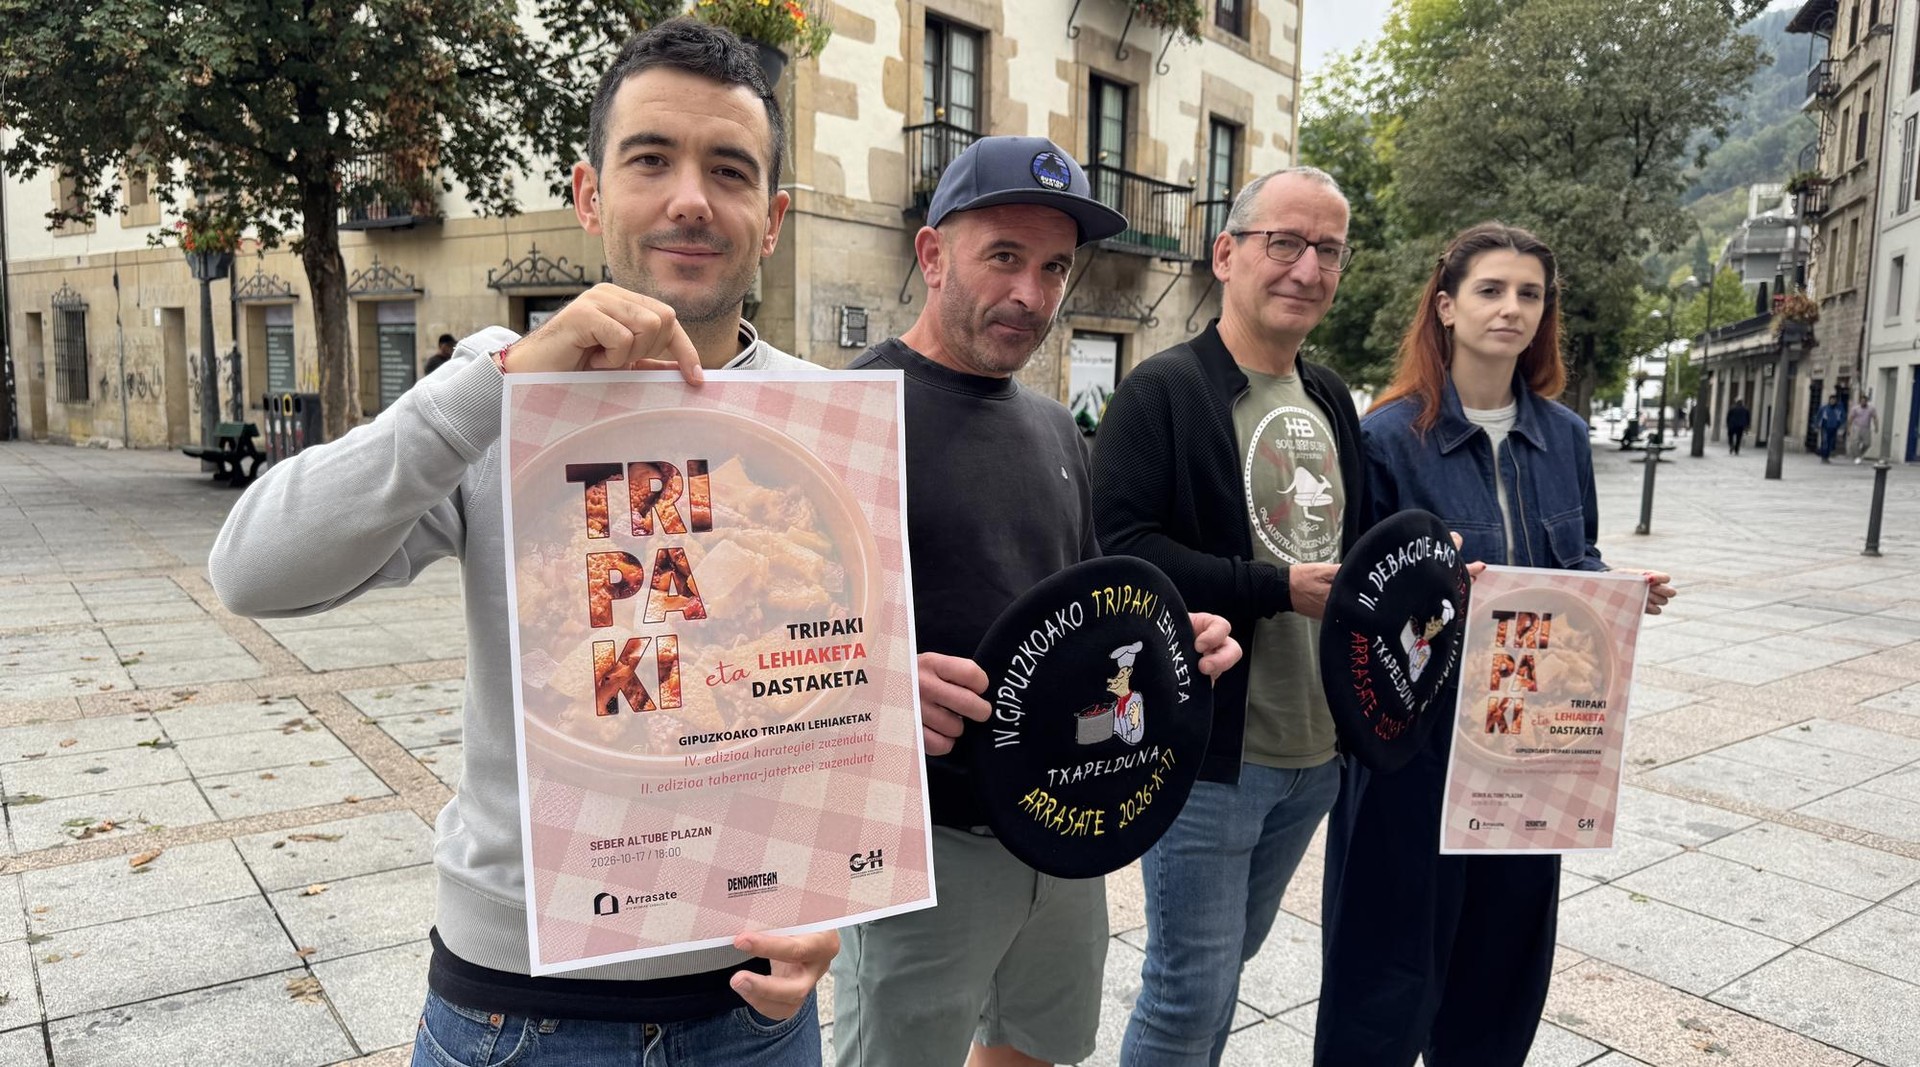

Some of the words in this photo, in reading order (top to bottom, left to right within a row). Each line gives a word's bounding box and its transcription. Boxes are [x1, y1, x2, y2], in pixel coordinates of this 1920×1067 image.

[565, 459, 714, 539] TRI
[586, 547, 708, 628] PA
[1092, 584, 1158, 618] TRIPAKI
[786, 617, 864, 640] TRIPAKI
[1491, 610, 1552, 649] TRI
[758, 643, 867, 670] LEHIAKETA
[1373, 635, 1415, 711] TXAPELDUNA
[1490, 653, 1538, 692] PA
[592, 634, 683, 717] KI
[705, 661, 750, 687] eta
[752, 669, 868, 698] DASTAKETA
[1351, 631, 1378, 718] ARRASATE
[1485, 697, 1524, 734] KI
[1555, 712, 1605, 722] LEHIAKETA
[1571, 700, 1606, 709] TRIPAKI
[678, 728, 758, 746] GIPUZKOAKO
[761, 722, 805, 736] TRIPAKI
[808, 712, 872, 730] LEHIAKETAK
[1550, 726, 1604, 736] DASTAKETA
[684, 755, 701, 767] IV.
[704, 751, 750, 766] edizioa
[753, 742, 815, 759] harategiei
[818, 732, 875, 749] zuzenduta
[1047, 745, 1160, 788] TXAPELDUNA
[641, 783, 653, 794] II.
[657, 778, 704, 793] edizioa
[708, 763, 814, 787] taberna-jatetxeei
[818, 753, 875, 770] zuzenduta
[1018, 787, 1105, 836] ARRASATE
[1118, 748, 1176, 829] 2026-X-17
[590, 838, 625, 851] SEBER
[627, 831, 669, 846] ALTUBE
[671, 826, 712, 841] PLAZAN
[590, 851, 645, 868] 2026-10-17
[655, 846, 681, 860] 18:00
[625, 891, 678, 905] Arrasate
[727, 871, 778, 891] DENDARTEAN
